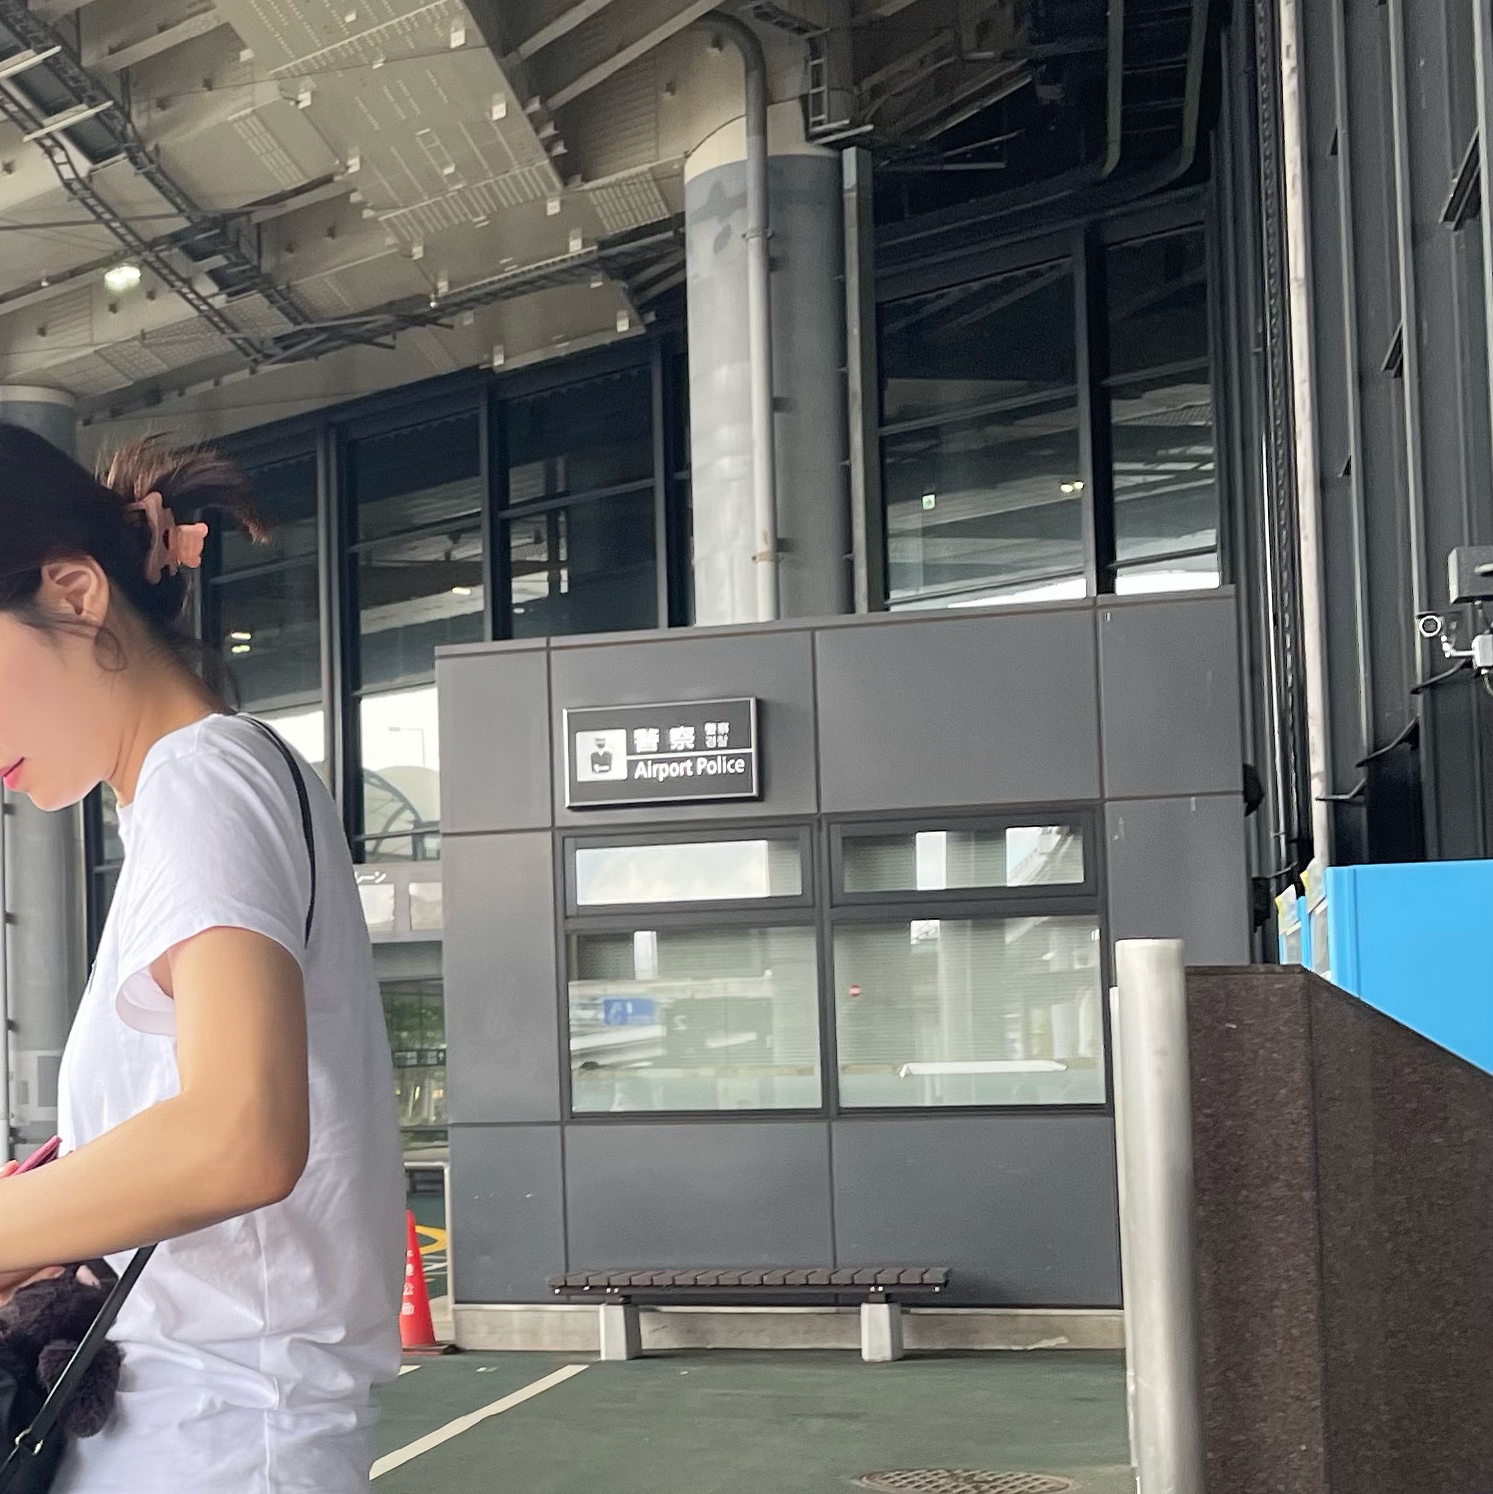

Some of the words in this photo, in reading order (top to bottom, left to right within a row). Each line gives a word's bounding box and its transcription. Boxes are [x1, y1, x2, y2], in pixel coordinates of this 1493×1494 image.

[633, 725, 696, 753] 警察
[634, 759, 693, 782] Airport
[696, 756, 746, 776] Police
